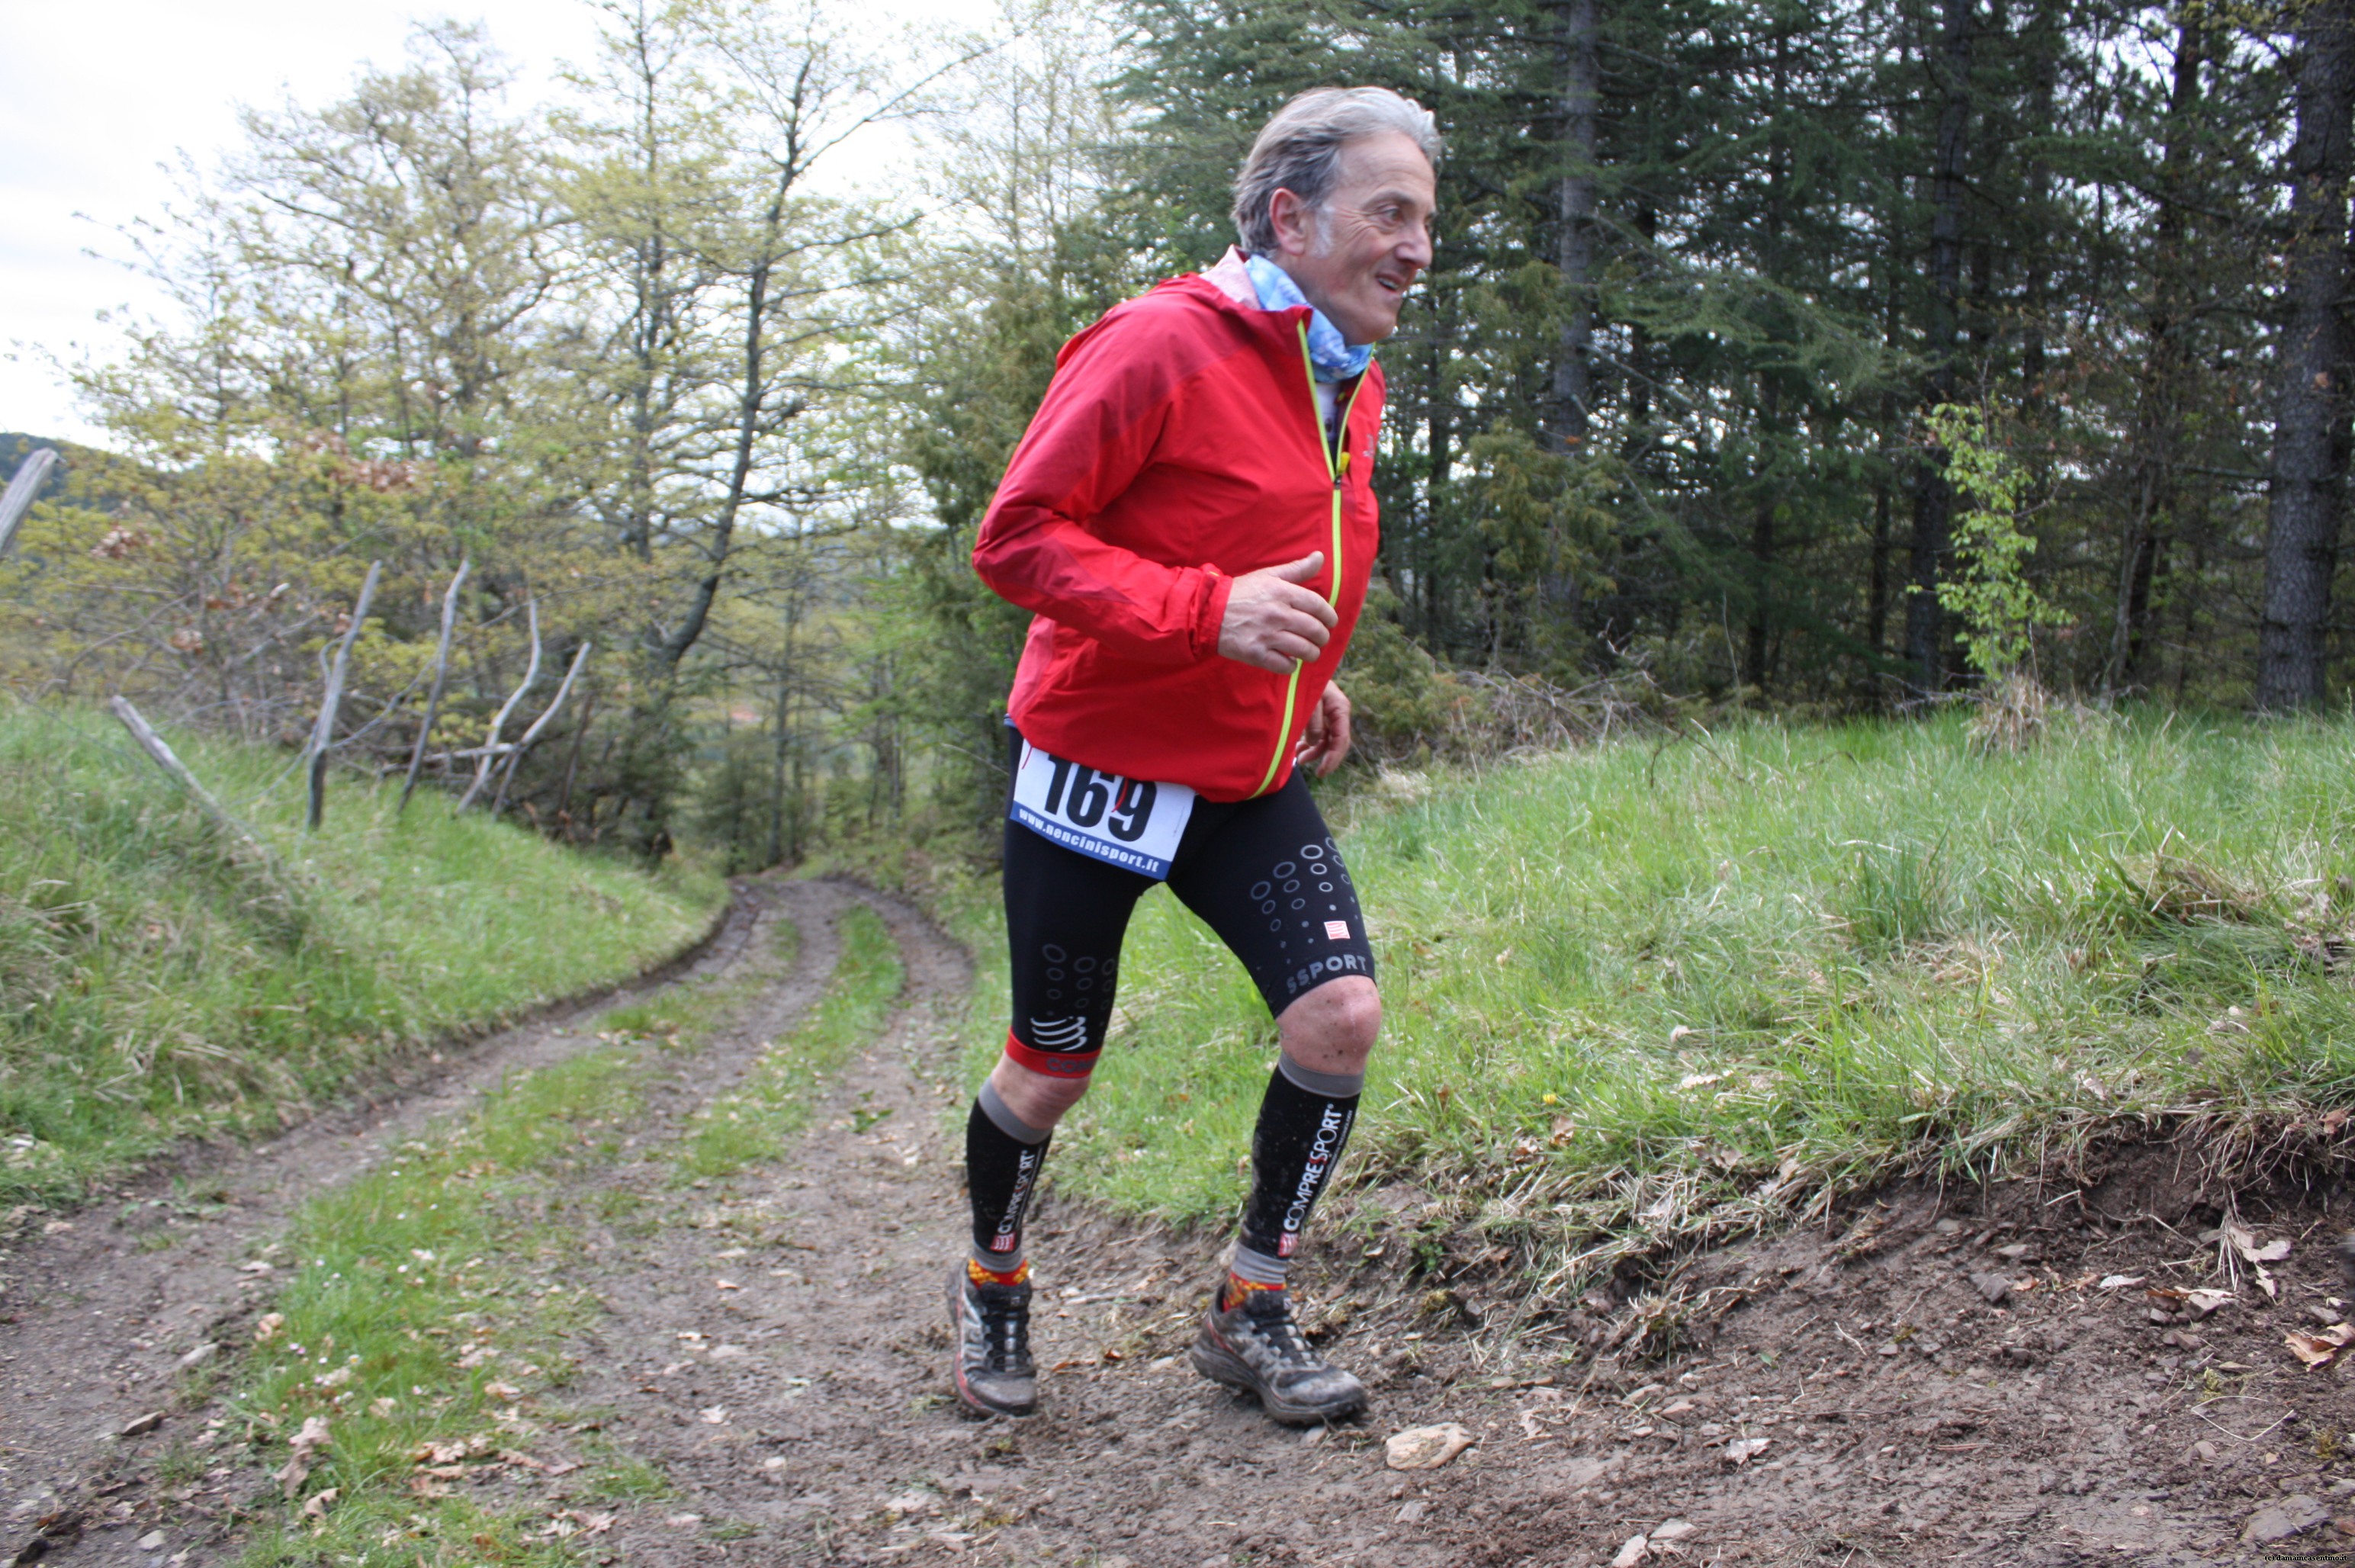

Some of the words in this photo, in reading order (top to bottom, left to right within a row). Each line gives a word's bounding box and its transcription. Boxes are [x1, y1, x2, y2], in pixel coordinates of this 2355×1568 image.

[1018, 808, 1160, 873] www.nencinisport.it
[1044, 753, 1157, 842] 169
[1284, 1108, 1342, 1232] COMPRESSPORT
